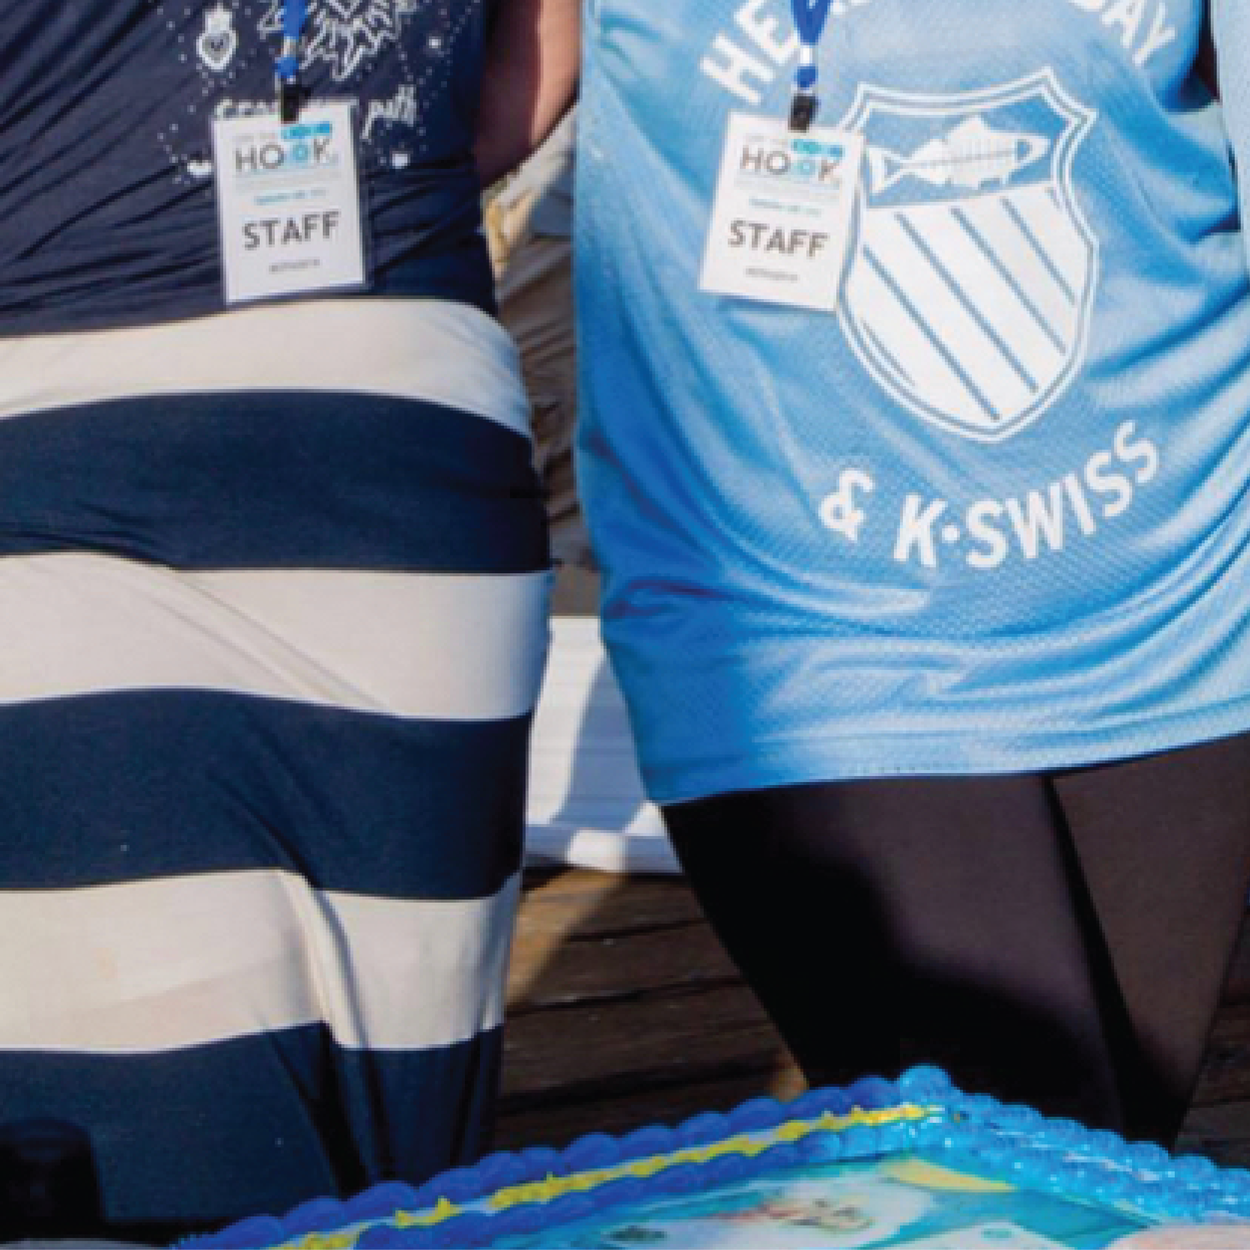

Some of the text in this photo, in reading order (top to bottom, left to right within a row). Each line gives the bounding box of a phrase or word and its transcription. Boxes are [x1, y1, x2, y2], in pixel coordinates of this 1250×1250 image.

[242, 209, 342, 251] STAFF
[728, 217, 831, 258] STAFF
[818, 466, 876, 544] &
